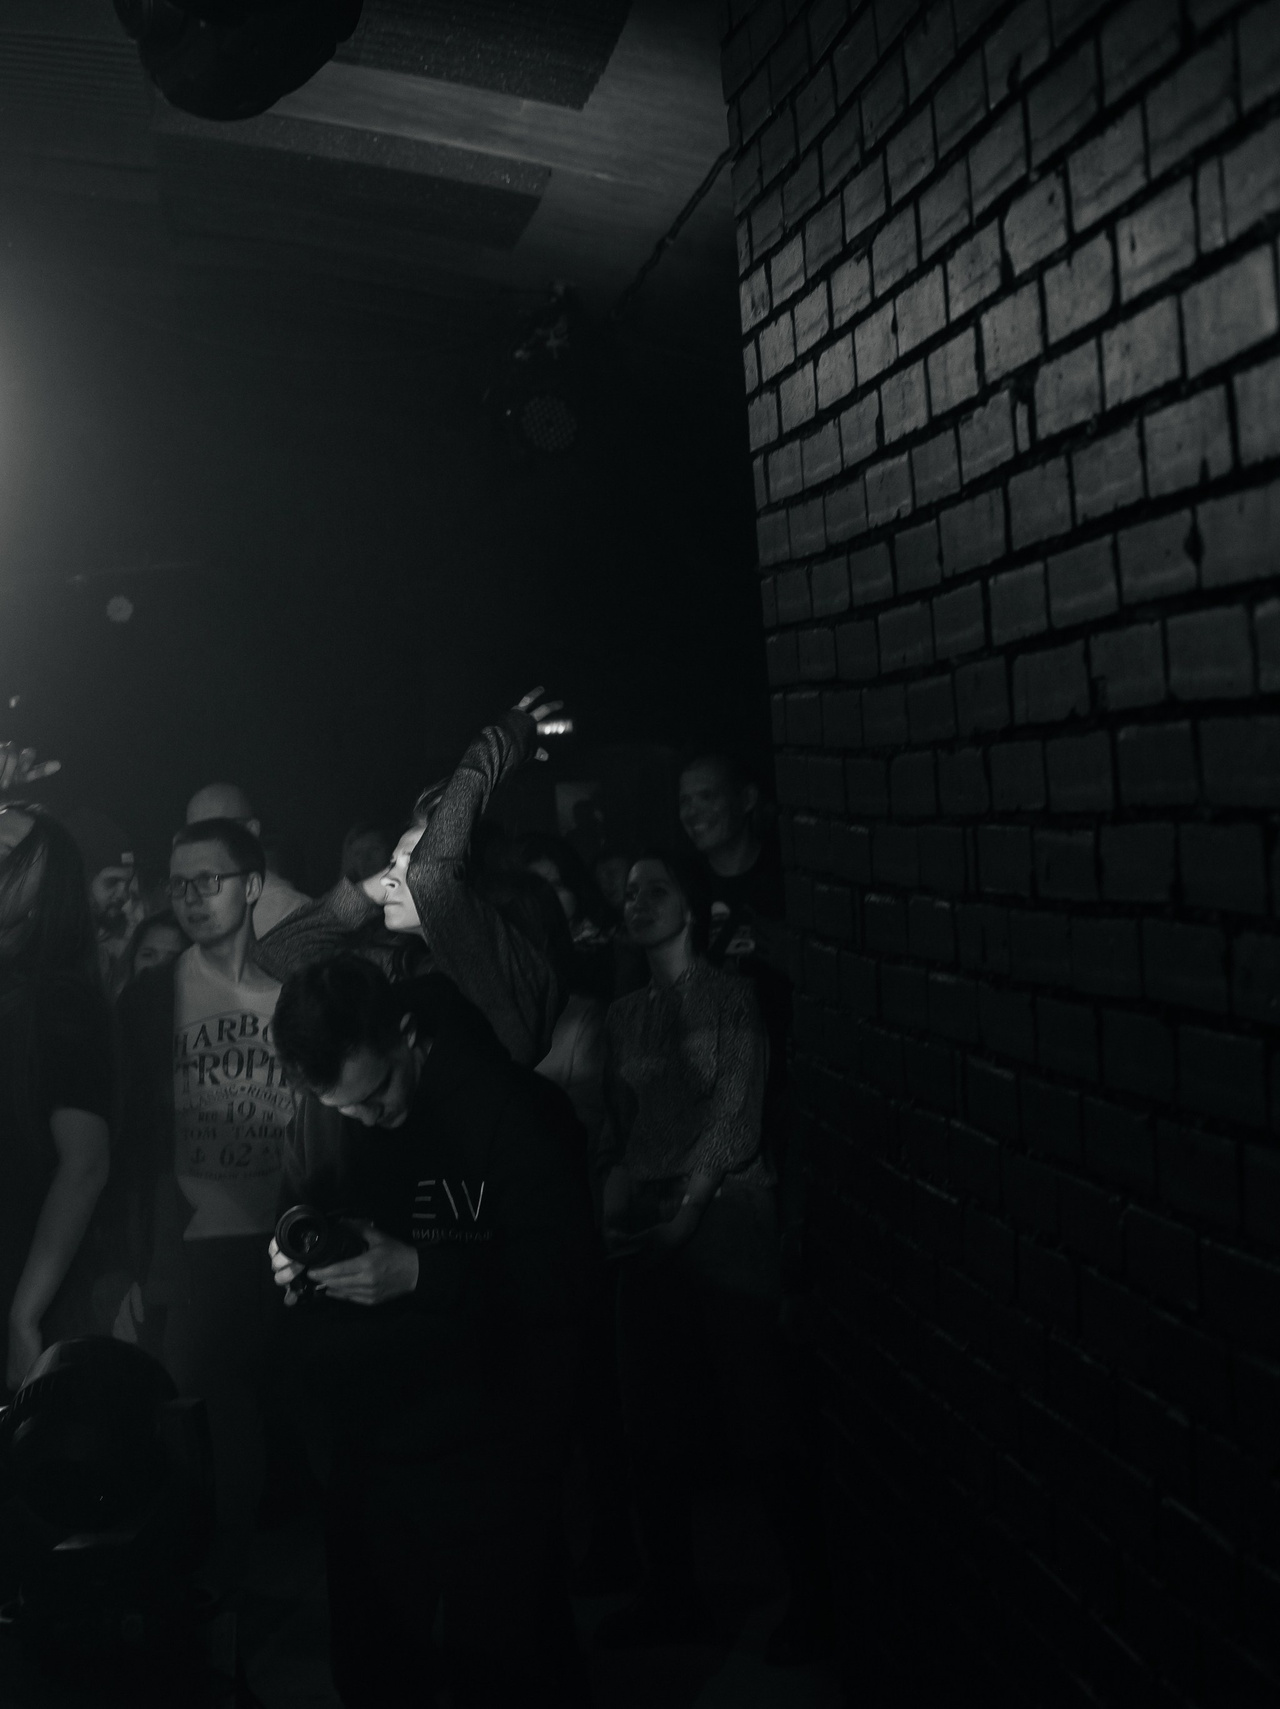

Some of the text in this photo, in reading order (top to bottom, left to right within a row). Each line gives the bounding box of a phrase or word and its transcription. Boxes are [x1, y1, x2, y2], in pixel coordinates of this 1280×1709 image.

[225, 1101, 256, 1124] 19
[232, 1125, 285, 1140] TAILO
[219, 1143, 253, 1168] 62
